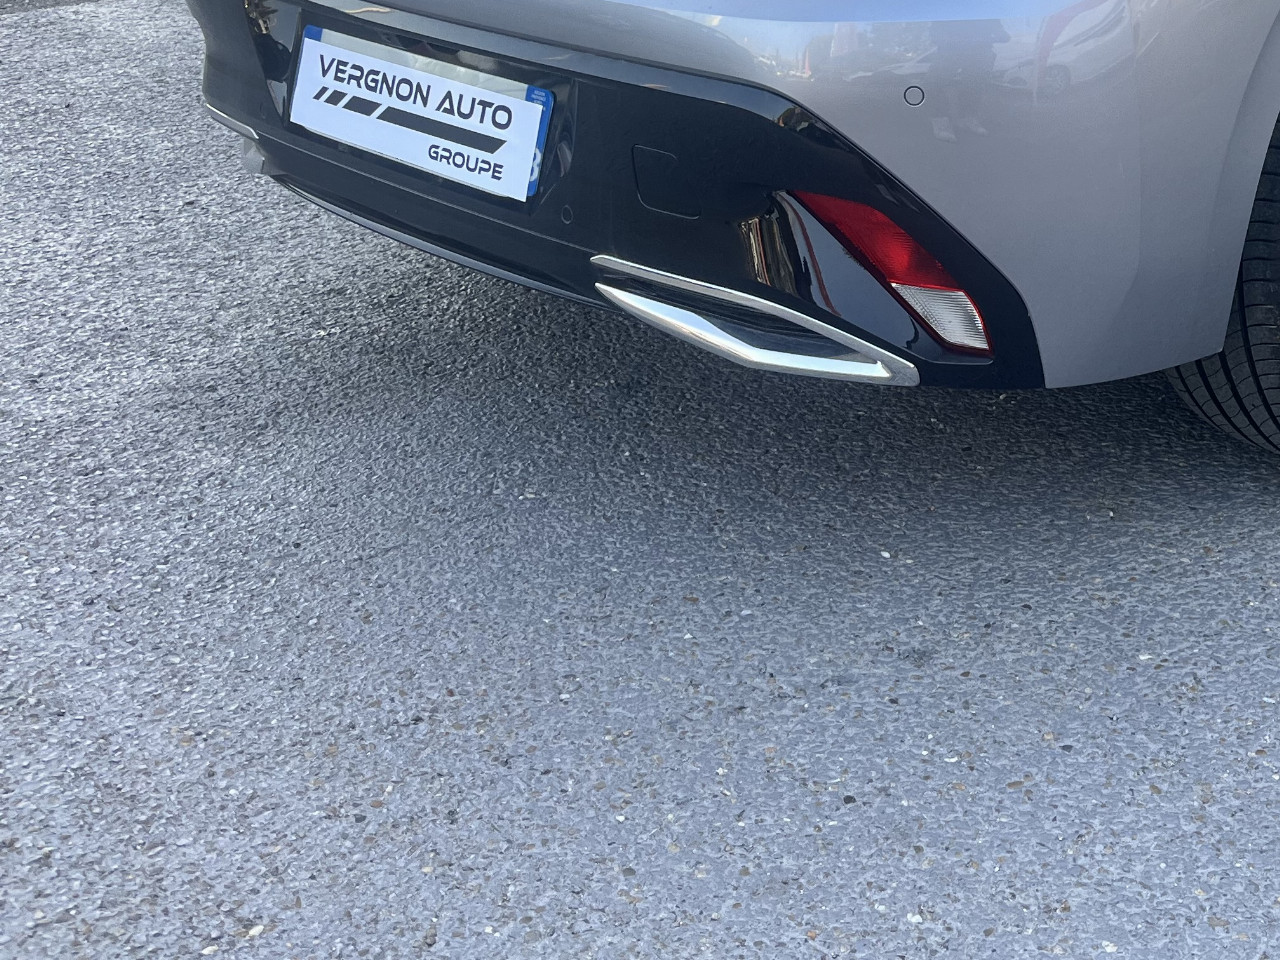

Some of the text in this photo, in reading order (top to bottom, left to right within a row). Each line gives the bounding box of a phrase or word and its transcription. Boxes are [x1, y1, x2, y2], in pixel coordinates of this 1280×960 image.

[319, 54, 432, 108] VERGNON
[435, 90, 513, 130] AUTO
[428, 144, 504, 181] GROUPE
